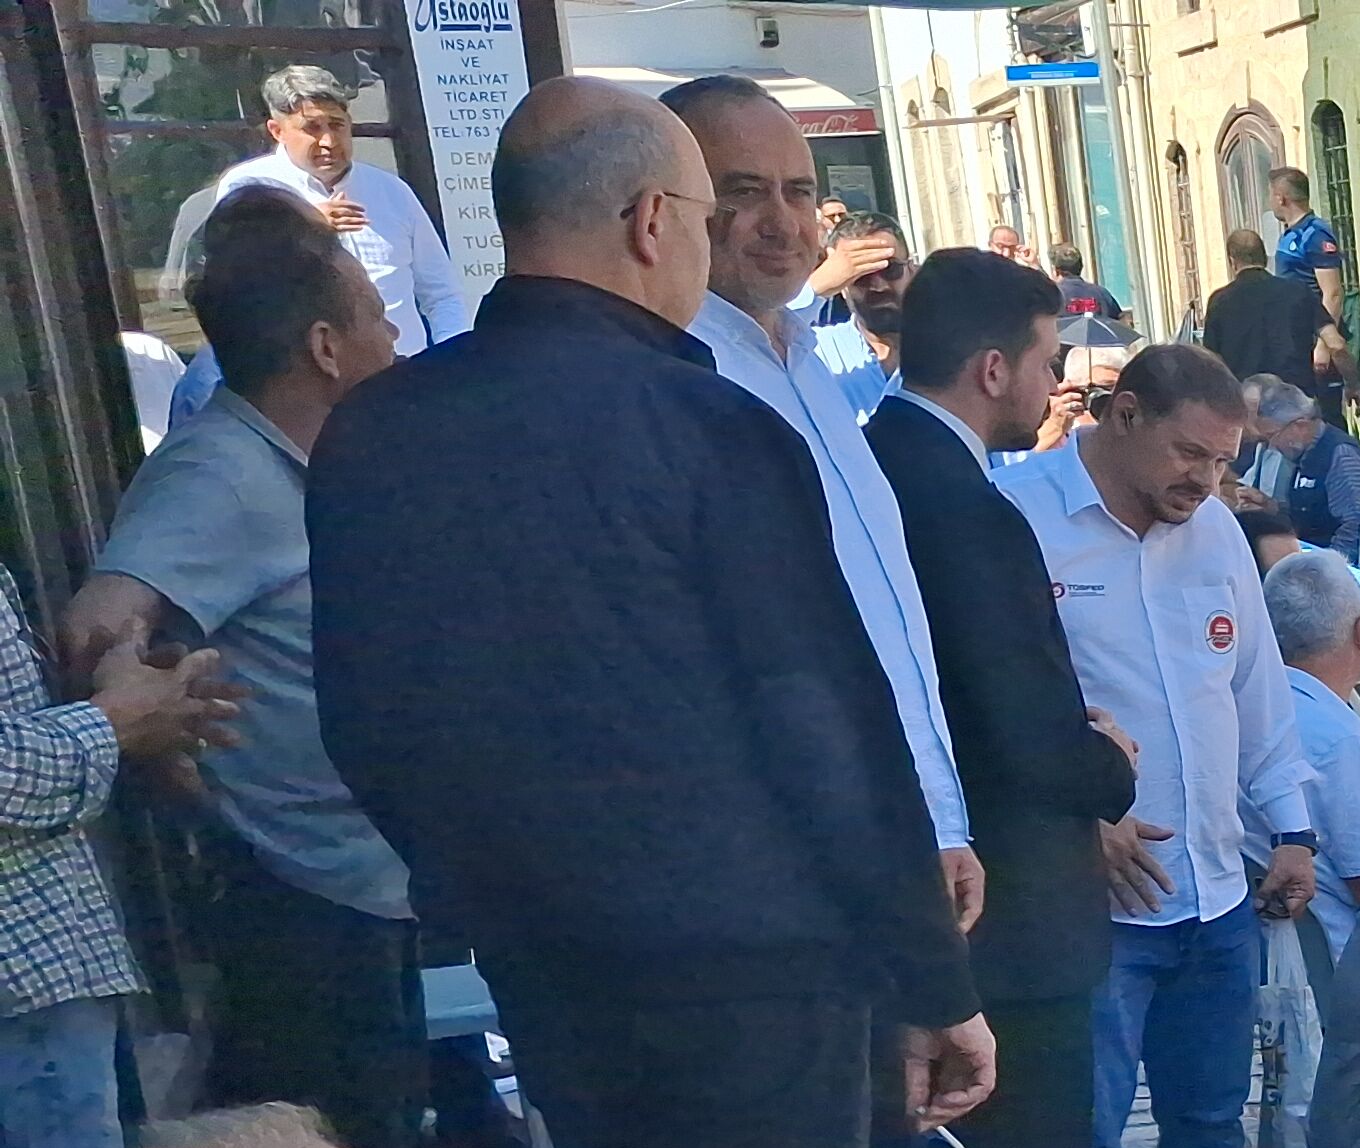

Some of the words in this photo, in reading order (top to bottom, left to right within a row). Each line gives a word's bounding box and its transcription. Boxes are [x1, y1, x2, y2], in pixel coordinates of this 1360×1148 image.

[461, 56, 480, 68] VE
[451, 152, 493, 165] DEM
[444, 174, 492, 193] ÇİME
[458, 203, 491, 219] KİR
[463, 231, 505, 249] TUĞ
[463, 260, 505, 276] KİRE
